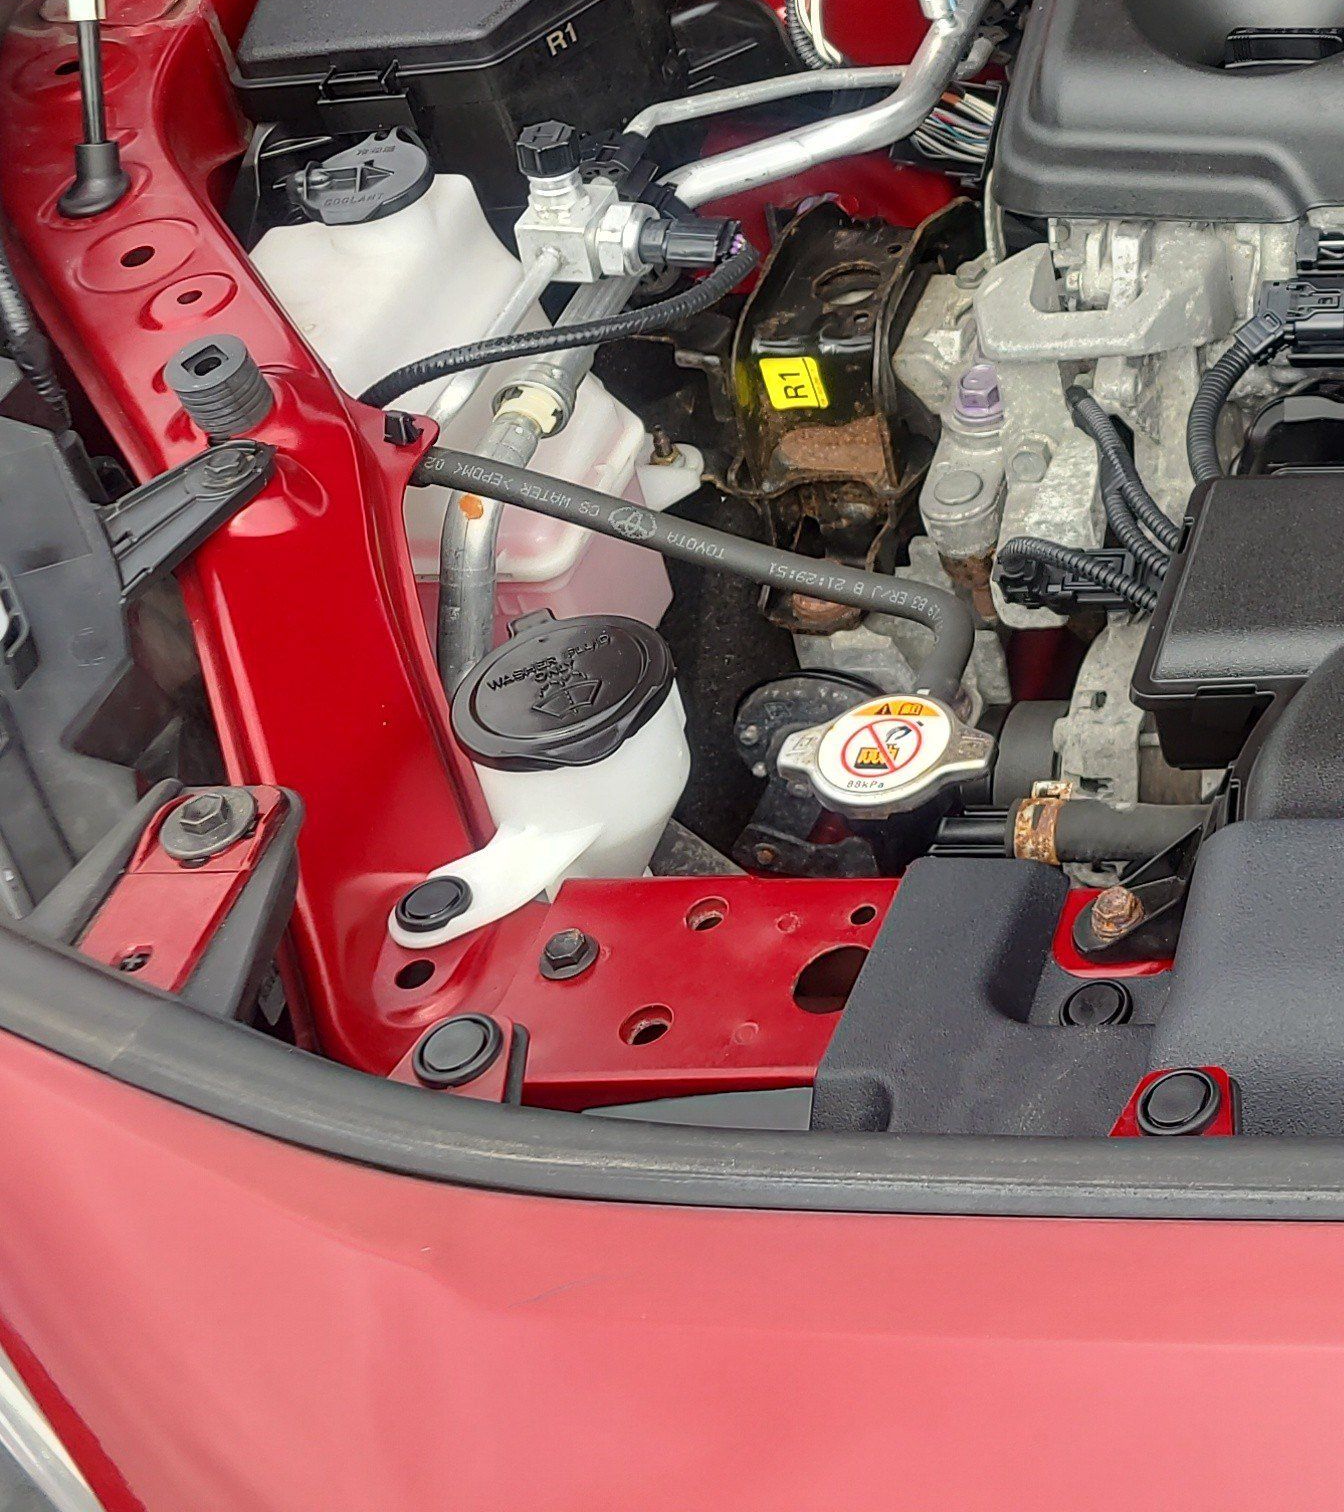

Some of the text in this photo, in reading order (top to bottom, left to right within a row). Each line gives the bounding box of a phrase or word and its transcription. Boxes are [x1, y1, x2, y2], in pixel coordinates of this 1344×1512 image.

[544, 21, 578, 56] R1
[324, 192, 384, 207] COOLANT
[520, 481, 572, 509] WATER
[578, 500, 600, 518] CS
[666, 531, 726, 561] TOYOTA
[769, 561, 846, 592] 21:29:51
[486, 634, 612, 693] WASHER FLUID
[846, 778, 886, 789] 88kPa
